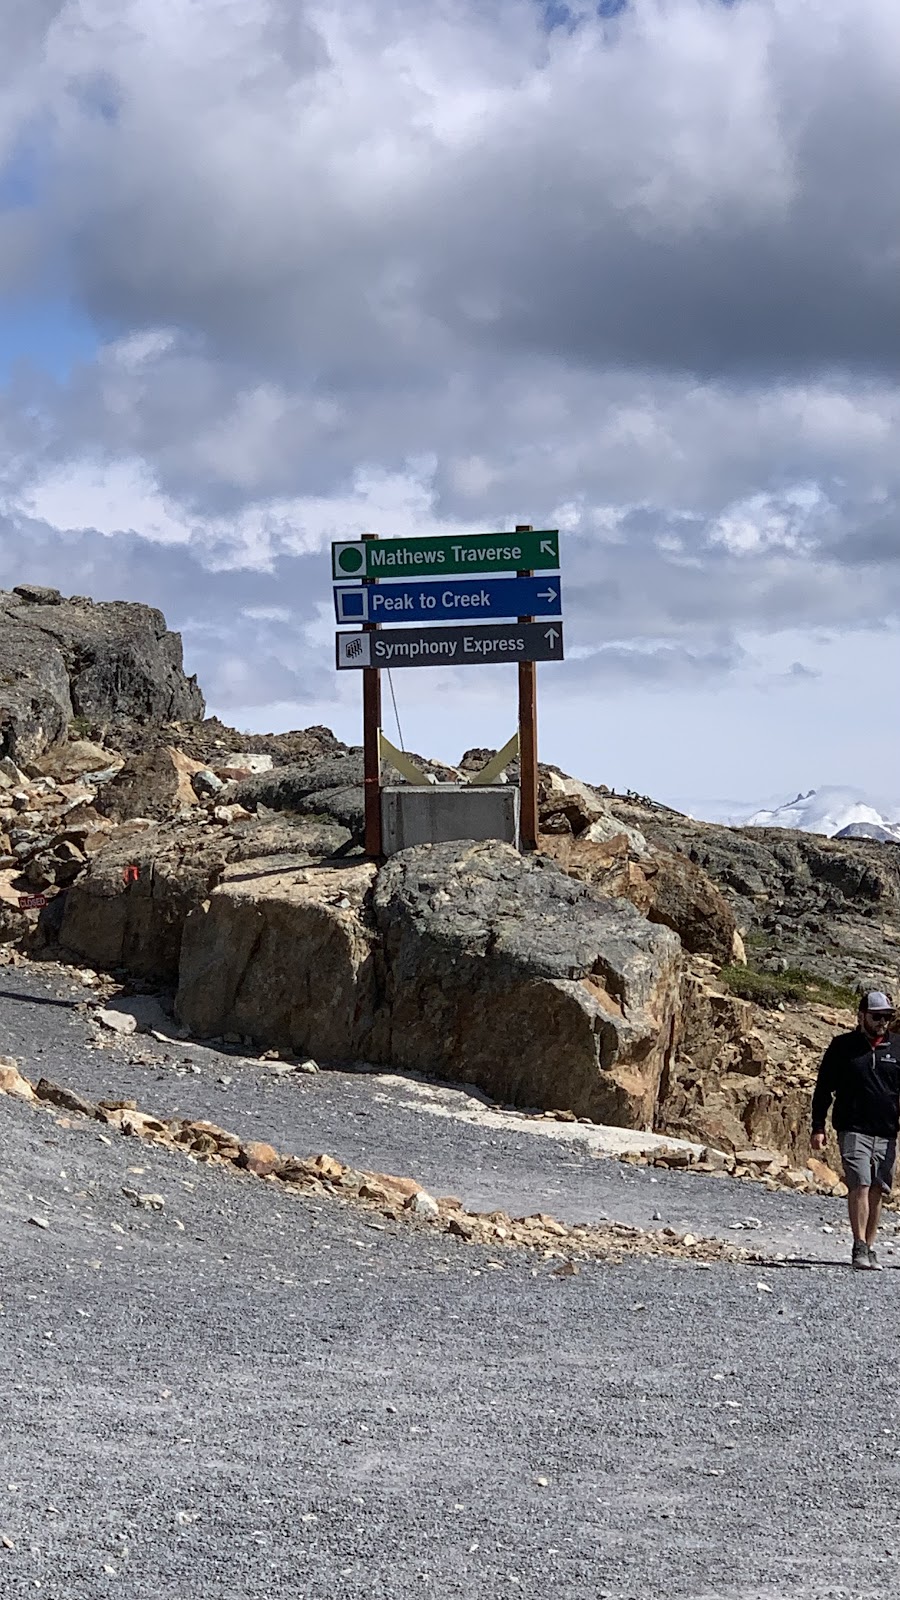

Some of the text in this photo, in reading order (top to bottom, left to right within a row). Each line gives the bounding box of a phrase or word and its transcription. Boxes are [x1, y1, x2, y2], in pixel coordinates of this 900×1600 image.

[370, 545, 522, 566] Mathews Traverse
[372, 590, 491, 610] Peak to Creek
[375, 636, 525, 659] Symphony Express
[20, 897, 46, 908] CLOSED
